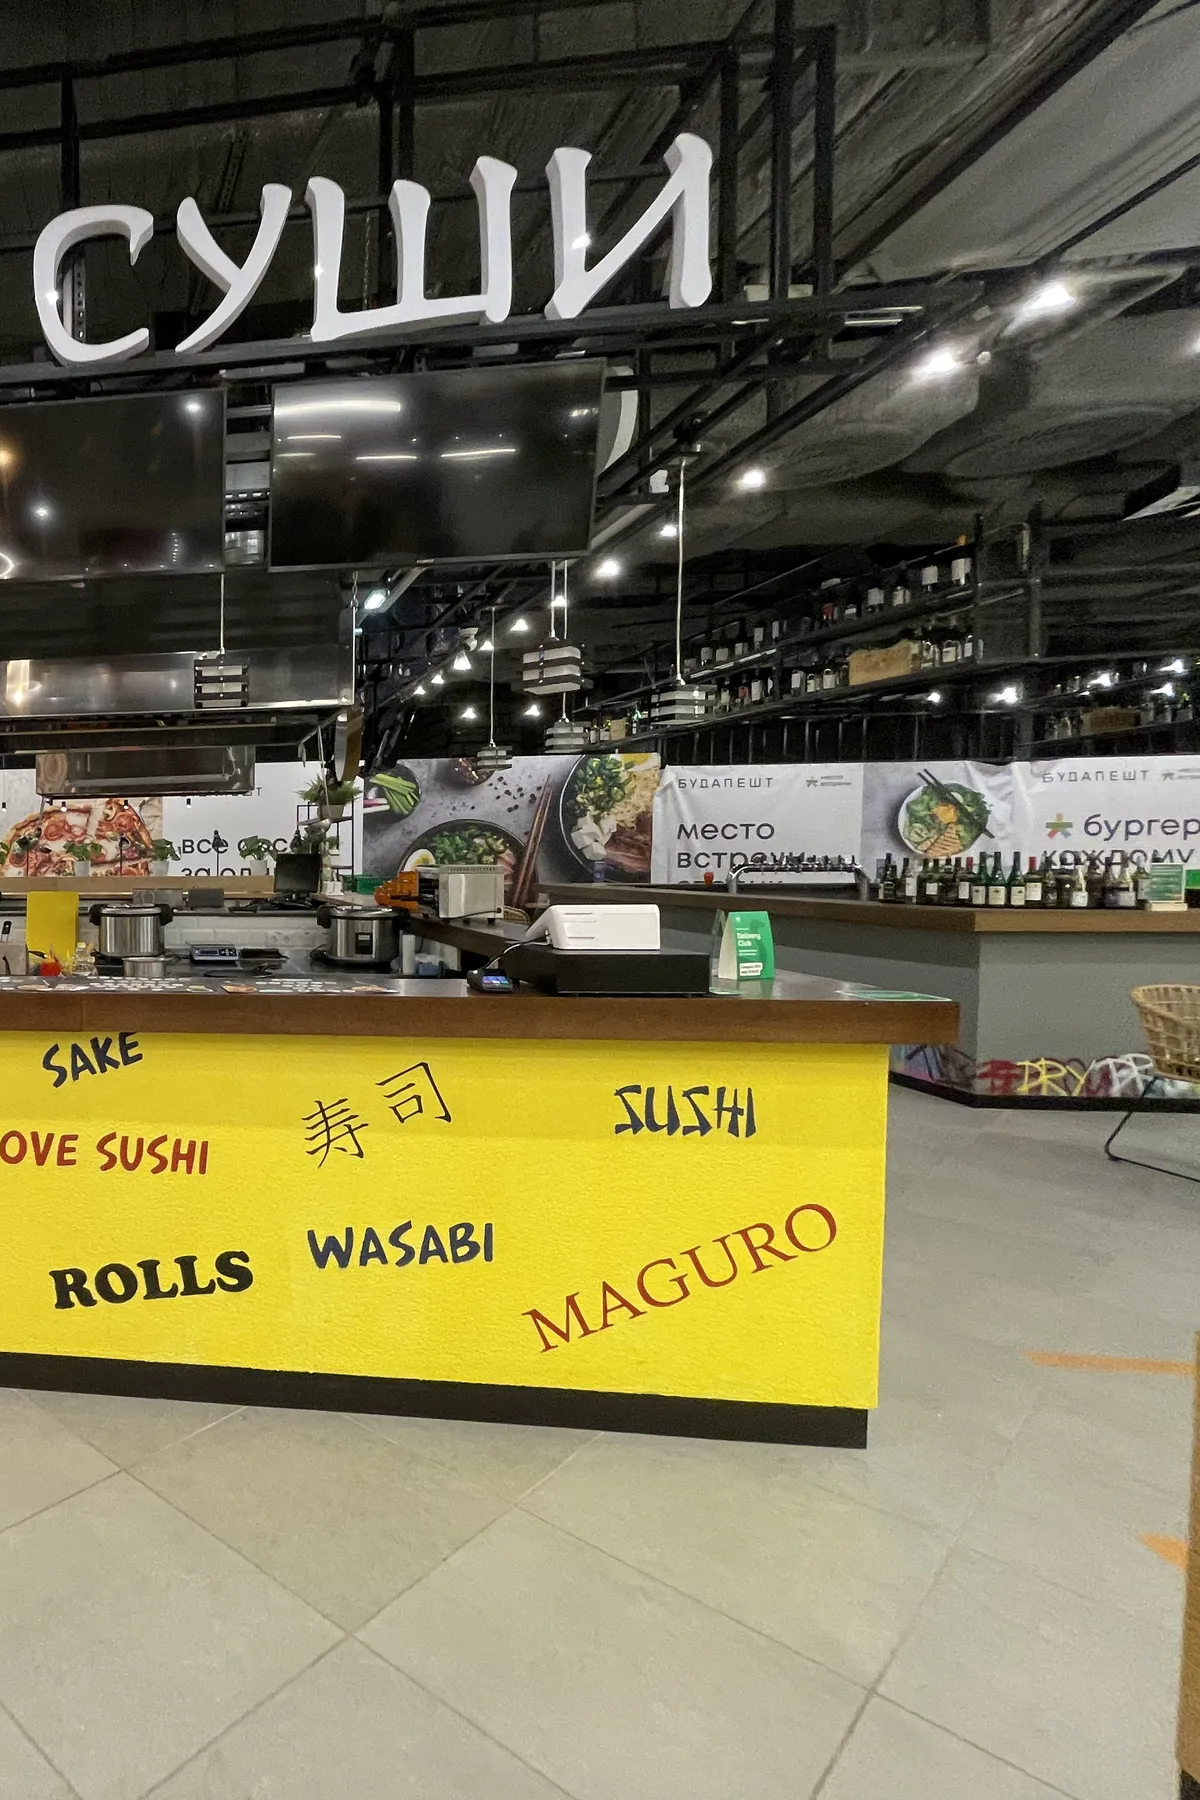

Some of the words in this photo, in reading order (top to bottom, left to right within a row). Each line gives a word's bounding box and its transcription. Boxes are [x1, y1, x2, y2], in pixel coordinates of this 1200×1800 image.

[33, 132, 713, 363] СУШИ
[678, 777, 773, 789] БУДАПЕШТ
[1042, 770, 1149, 783] БУДАПЕШТ
[677, 823, 775, 840] место
[42, 1032, 144, 1089] SAKE
[614, 1084, 757, 1139] SUSHI
[96, 1131, 210, 1176] SUSHI
[307, 1220, 494, 1270] WASABI
[49, 1250, 254, 1310] ROLLS
[521, 1203, 838, 1353] MAGURO
